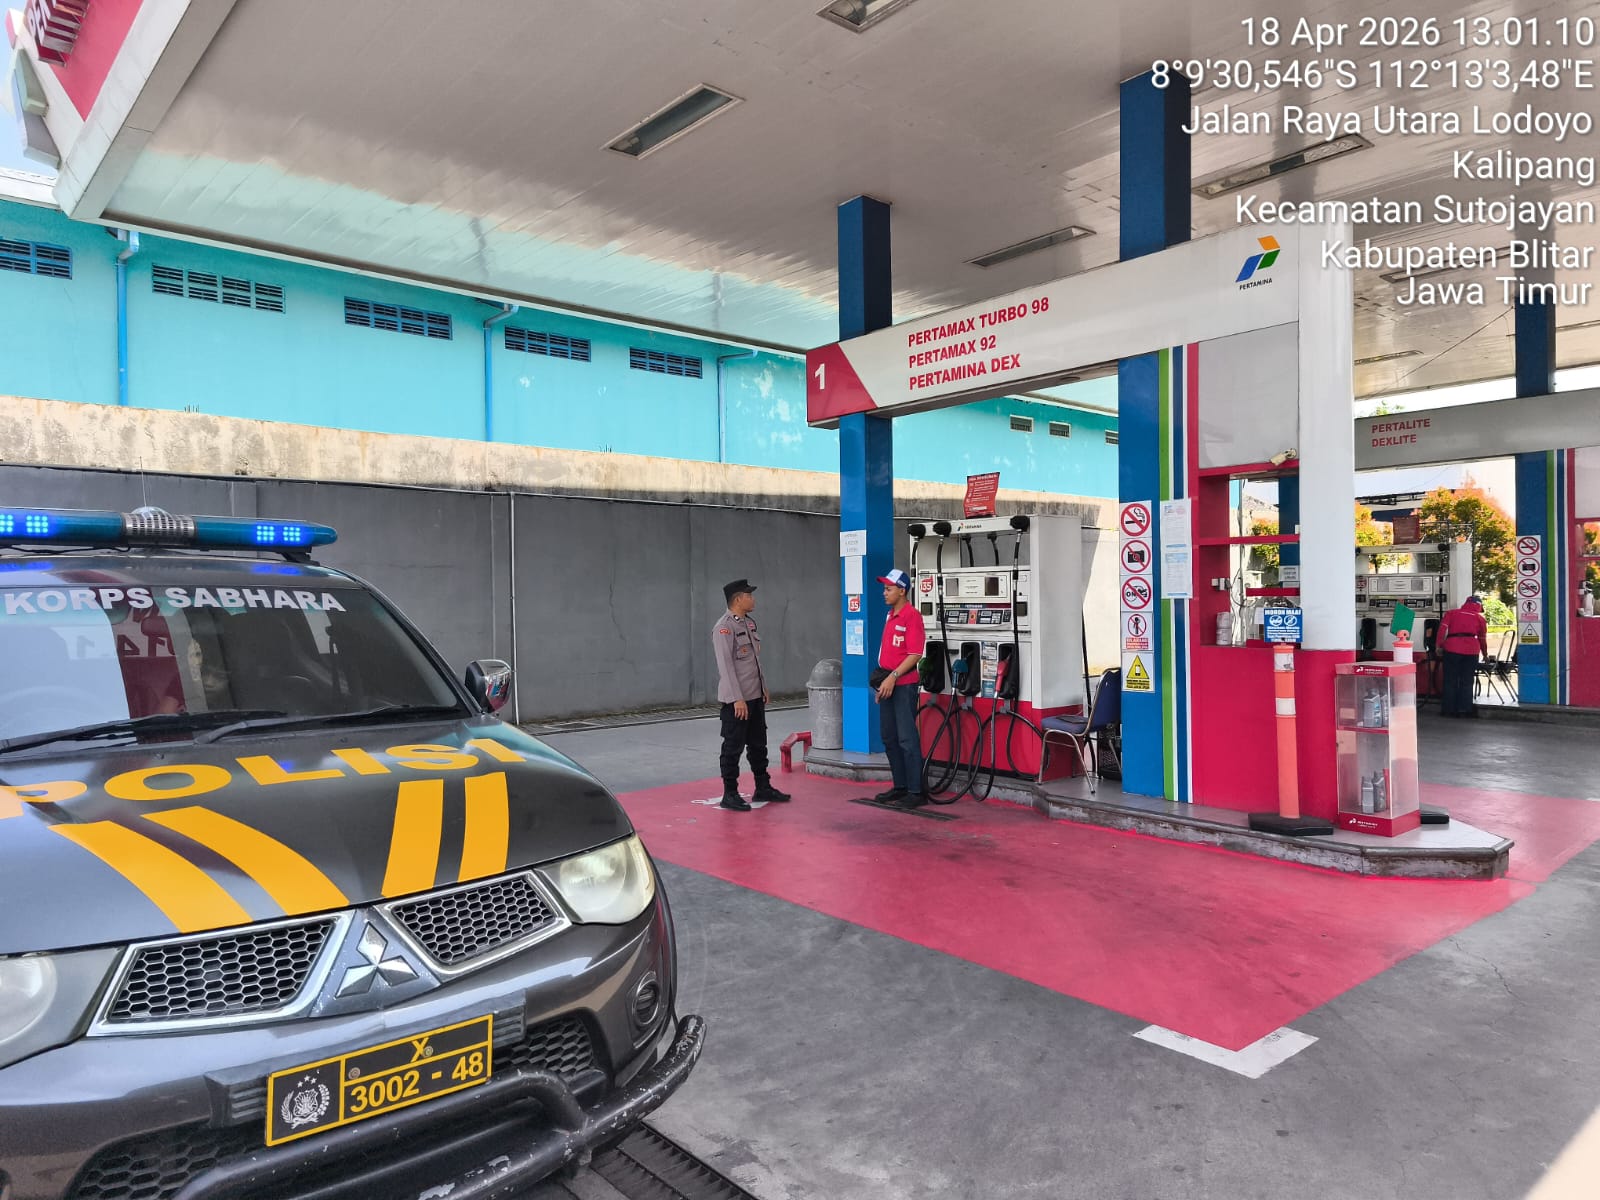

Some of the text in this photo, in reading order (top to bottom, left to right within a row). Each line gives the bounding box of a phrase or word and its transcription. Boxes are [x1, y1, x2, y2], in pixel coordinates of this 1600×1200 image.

[1240, 278, 1272, 290] PERTAMINA
[908, 297, 1050, 347] PERTAMAX TURBO 98
[908, 335, 996, 368] PERTAMAX 92
[814, 363, 826, 390] 1
[909, 354, 1020, 390] PERTAMINA DEX
[1372, 418, 1430, 433] PERTALITE
[1372, 434, 1416, 448] DEXLITE
[4, 587, 346, 614] KORPS SABHARA
[0, 738, 526, 819] POLISI
[410, 1037, 430, 1063] X
[350, 1070, 420, 1113] 3002
[452, 1052, 484, 1080] 48
